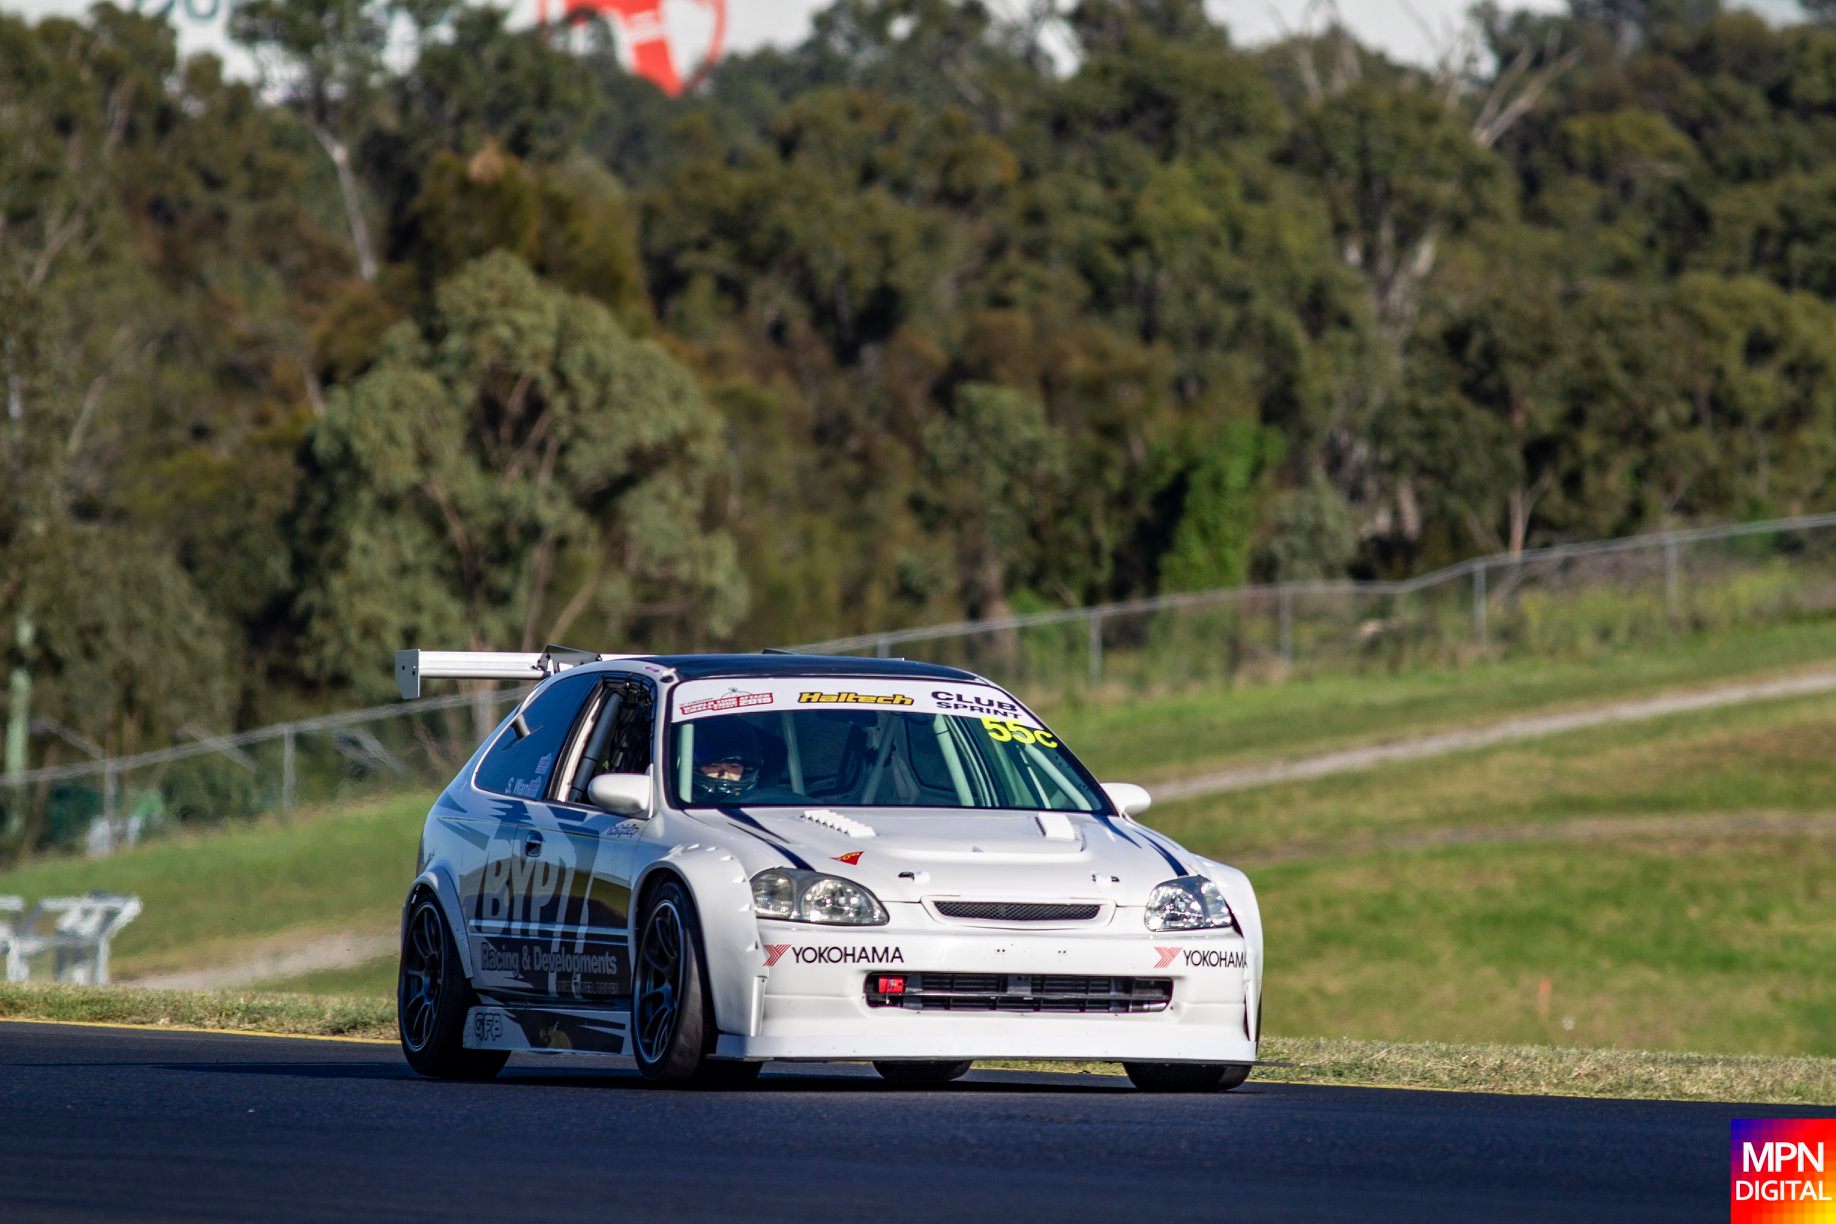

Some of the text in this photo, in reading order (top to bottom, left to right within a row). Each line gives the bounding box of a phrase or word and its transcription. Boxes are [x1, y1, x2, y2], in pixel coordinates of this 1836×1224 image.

[797, 691, 914, 706] Haltech
[931, 690, 1019, 712] CLUB
[936, 701, 1022, 720] SPRINT
[481, 942, 618, 979] Racing & Developments
[792, 946, 905, 963] YOKOHAMA
